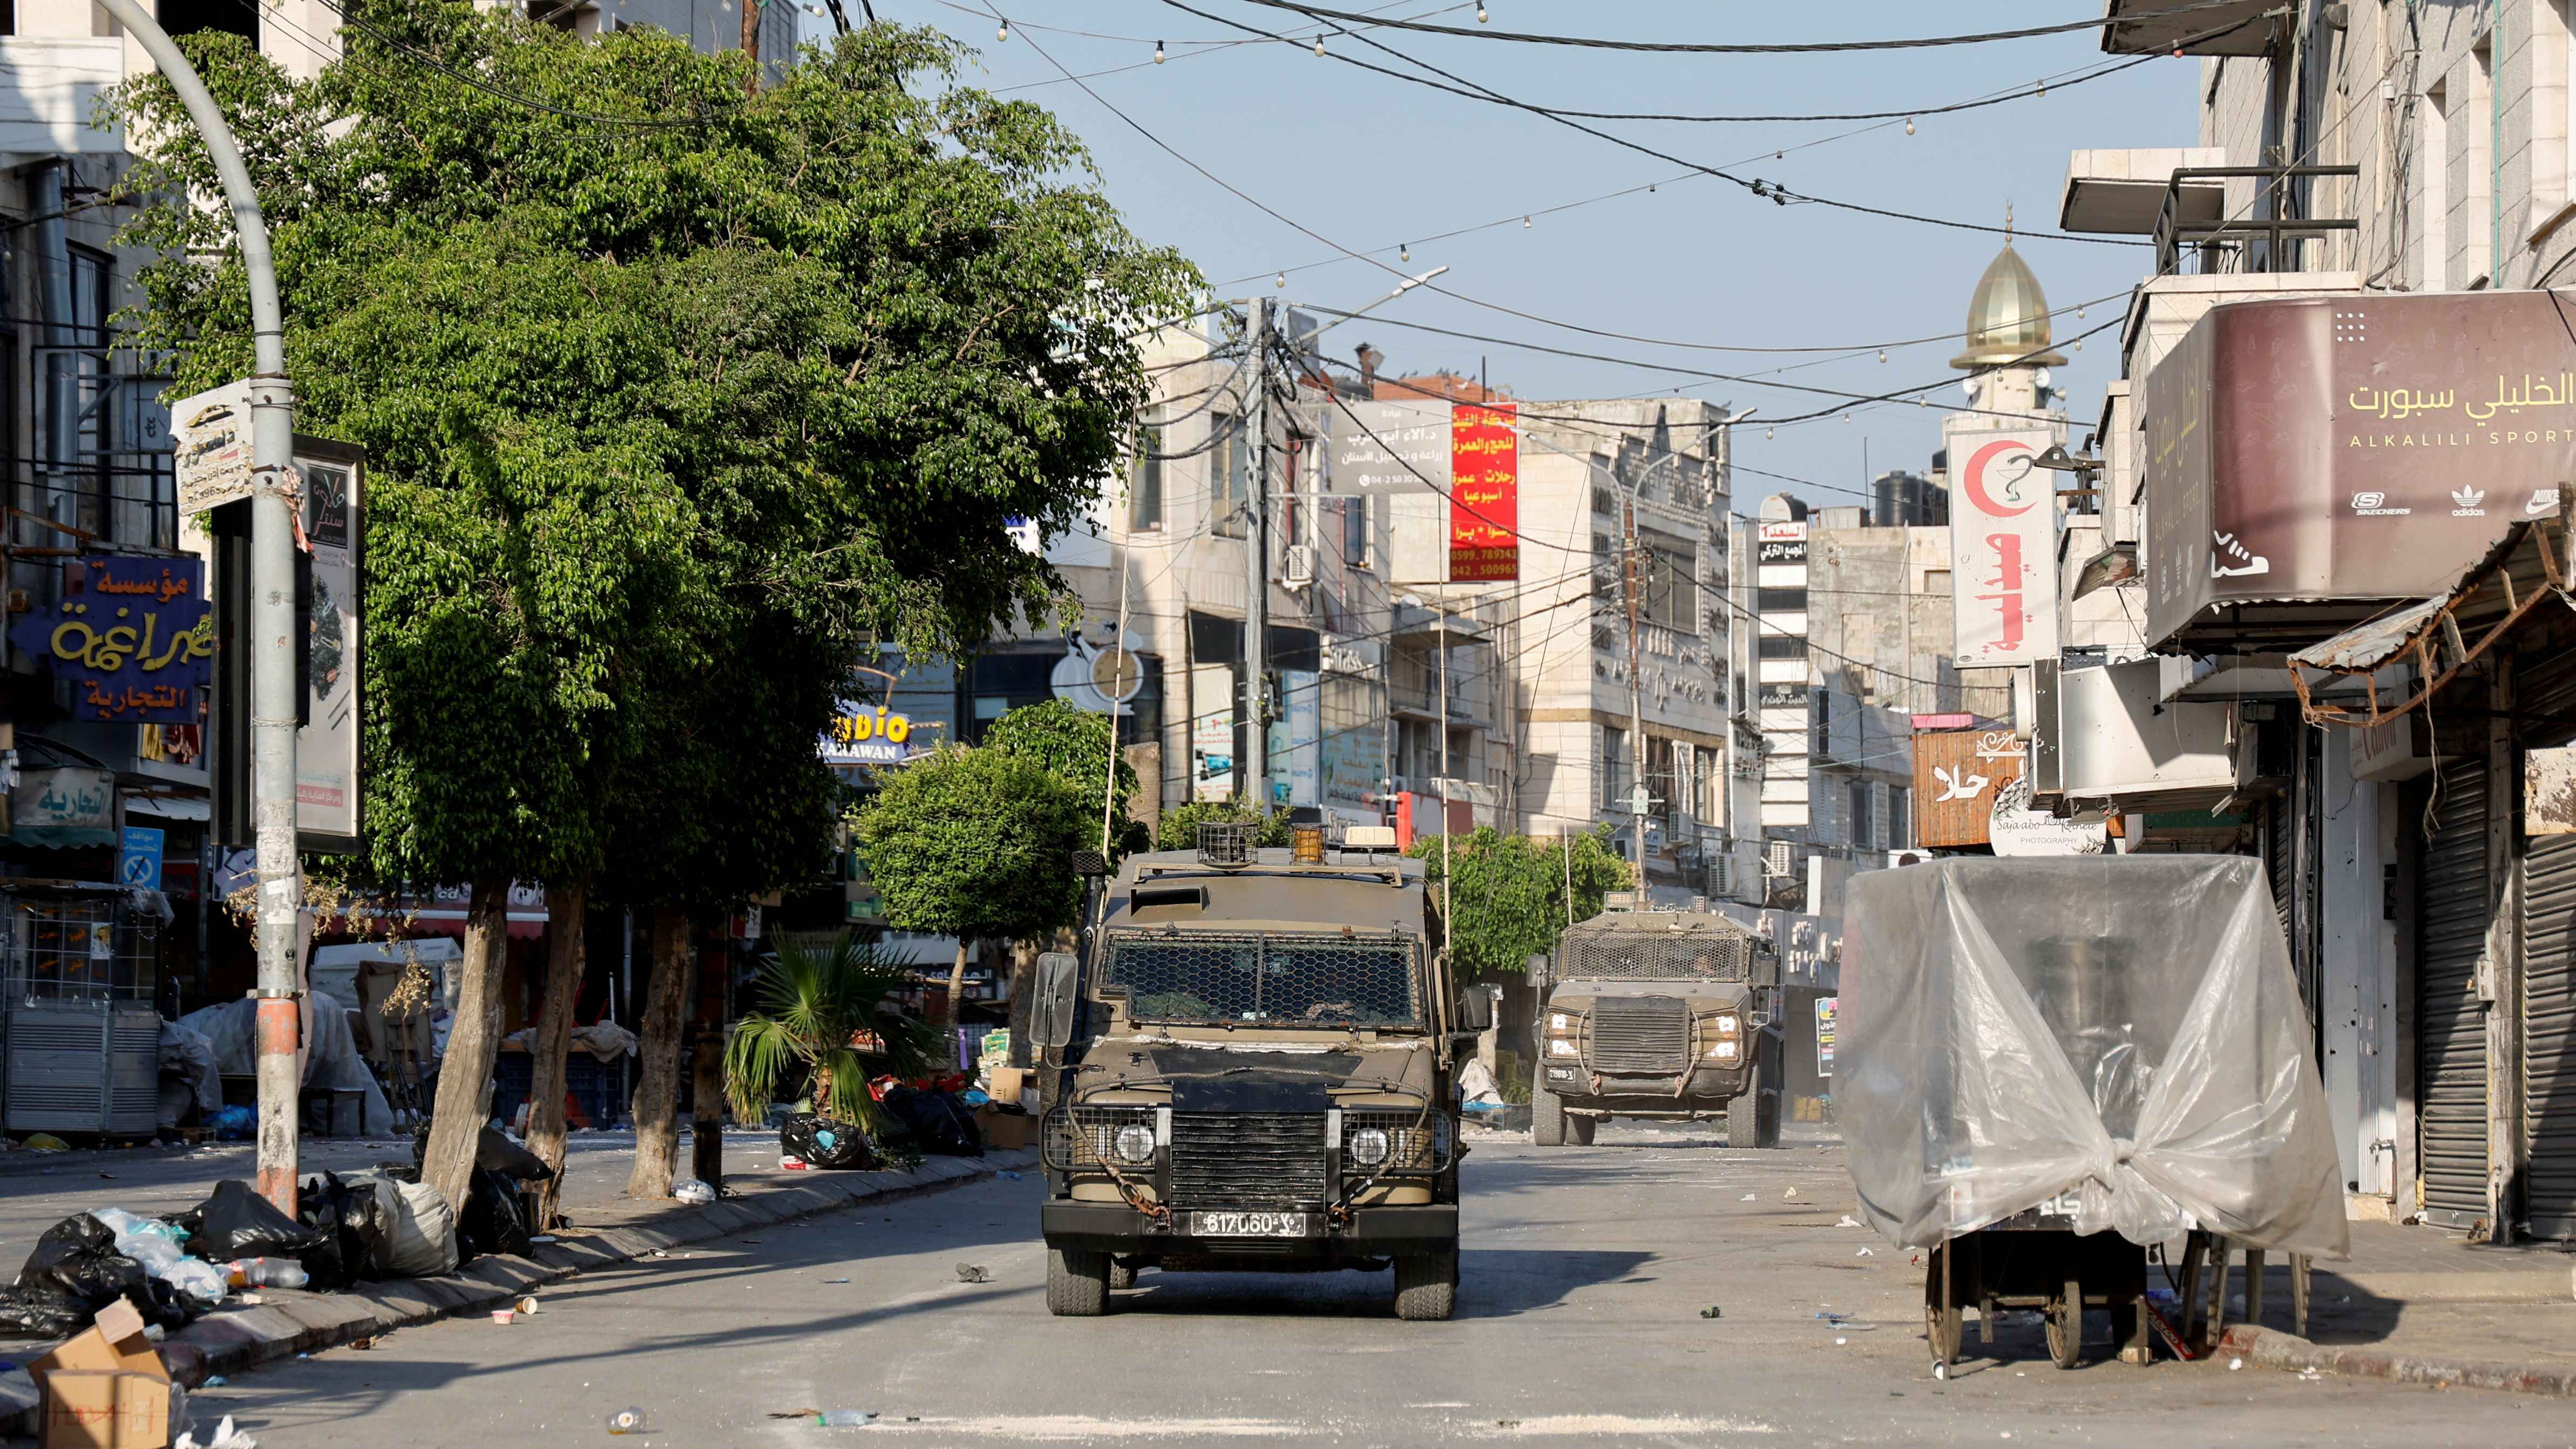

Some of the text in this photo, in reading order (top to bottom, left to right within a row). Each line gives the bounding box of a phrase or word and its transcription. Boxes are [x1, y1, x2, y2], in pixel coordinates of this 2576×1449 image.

[2349, 372, 2574, 427] الخليلي سبورت
[2350, 429, 2574, 448] ALKALILI SPORT
[2451, 507, 2485, 517] adidas
[91, 560, 188, 603] مؤسسة
[1974, 533, 2034, 654] صيدلية
[83, 680, 187, 719] التجارية
[1997, 818, 2021, 833] Saja
[2021, 818, 2040, 830] abo
